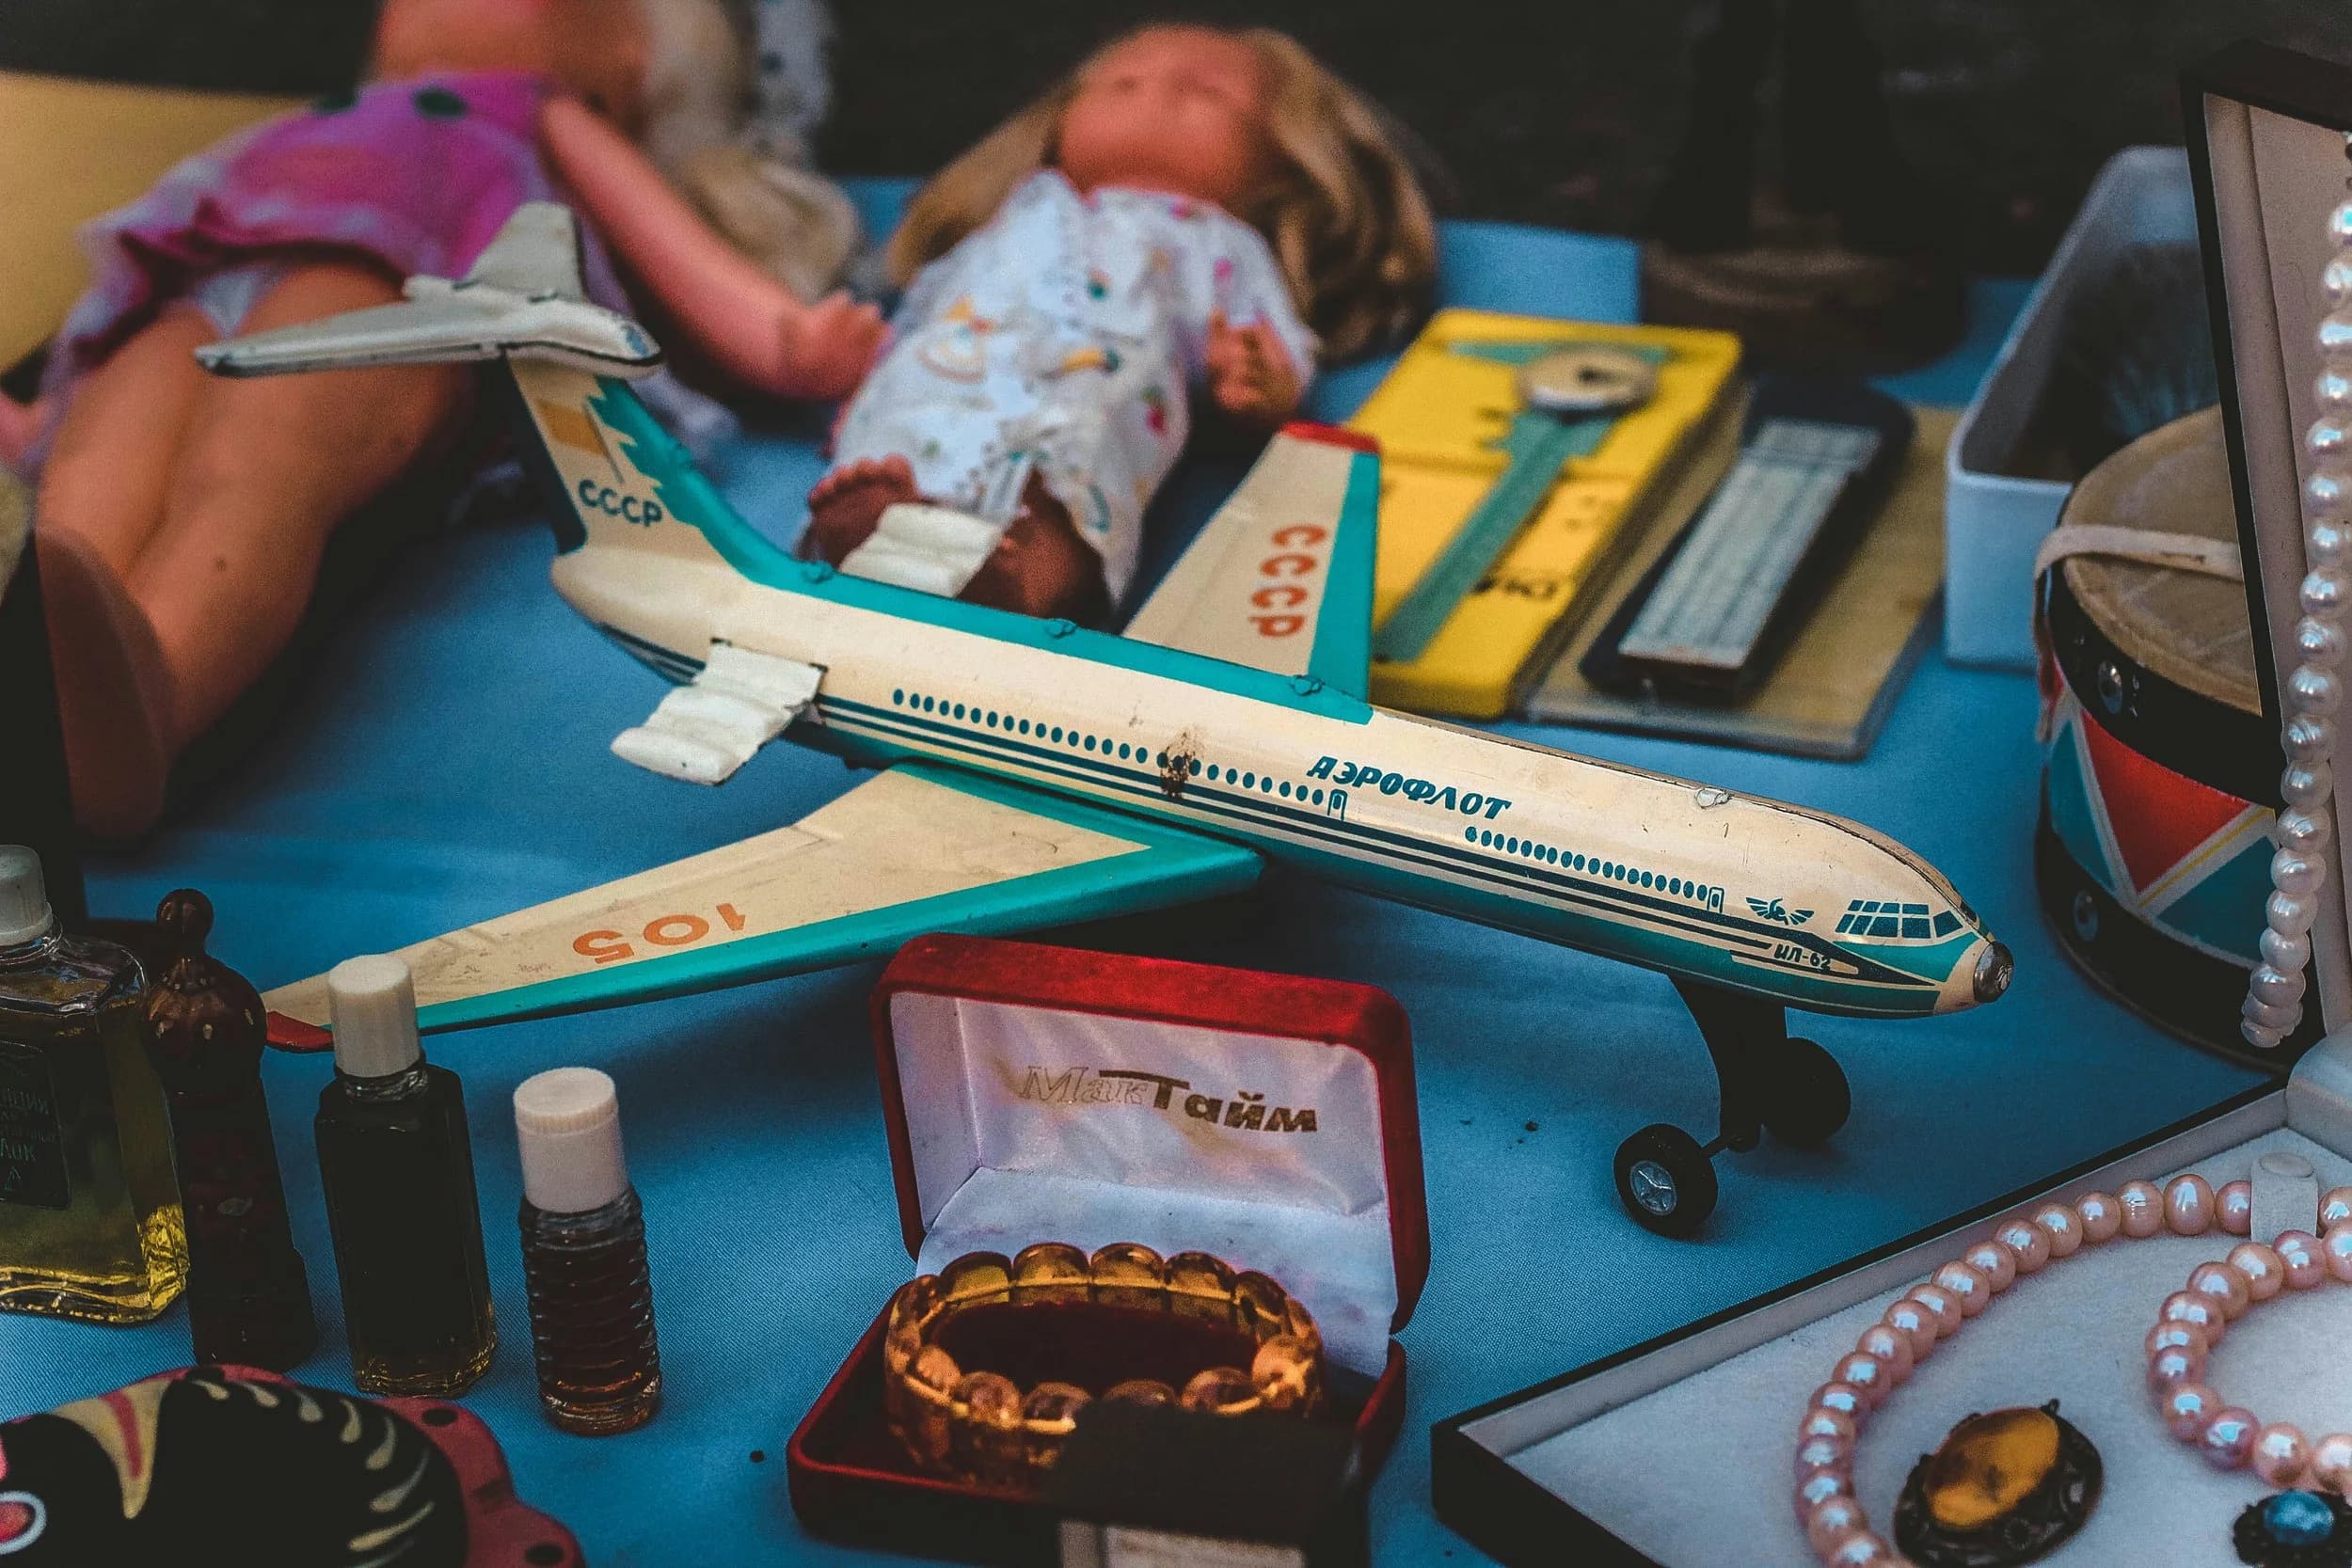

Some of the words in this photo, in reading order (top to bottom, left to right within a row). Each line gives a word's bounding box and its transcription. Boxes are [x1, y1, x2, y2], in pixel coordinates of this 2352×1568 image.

[578, 478, 663, 528] СССР
[1248, 523, 1328, 639] СССР
[1306, 755, 1513, 820] АЭРОФЛОТ
[572, 902, 747, 964] 105
[1773, 944, 1832, 970] ИЛ-62
